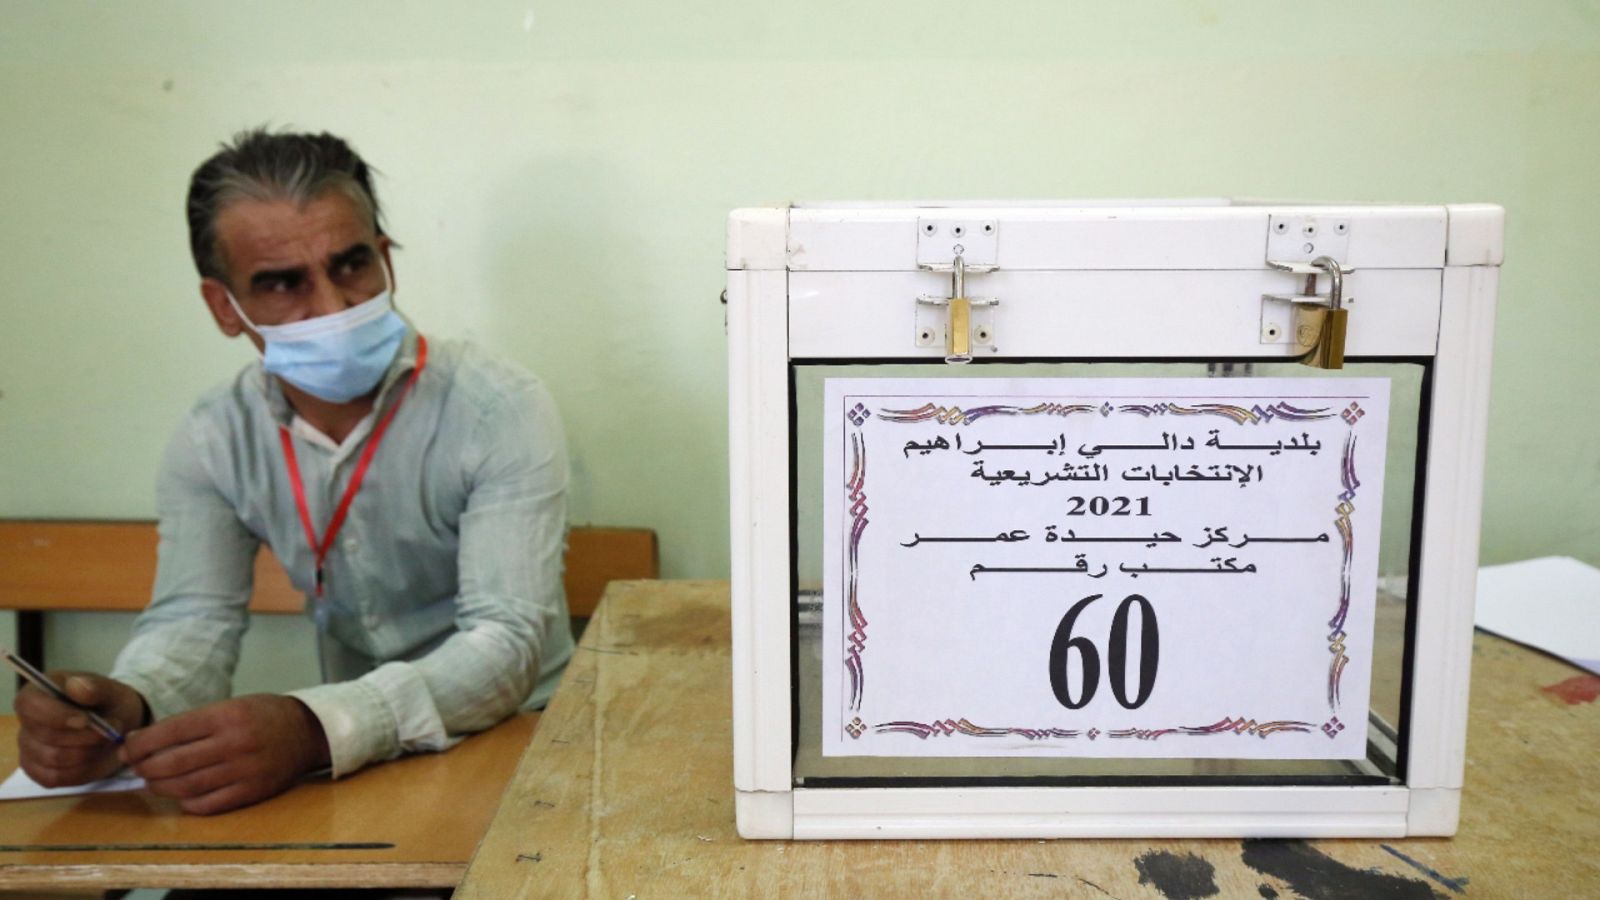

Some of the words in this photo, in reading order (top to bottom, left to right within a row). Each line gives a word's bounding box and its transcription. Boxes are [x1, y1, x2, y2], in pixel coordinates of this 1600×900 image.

[903, 433, 1066, 459] إبراهيم
[1077, 431, 1195, 459] دالي
[1205, 429, 1321, 456] بلدية
[970, 460, 1109, 487] التشريعية
[1121, 464, 1263, 488] الإنتخابات
[1066, 496, 1152, 517] 2021
[900, 526, 1031, 548] عمر
[1044, 524, 1182, 549] حيدة
[1192, 526, 1330, 549] مركز
[969, 553, 1108, 581] رقم
[1119, 557, 1257, 579] مكتب
[1048, 593, 1160, 710] 60
